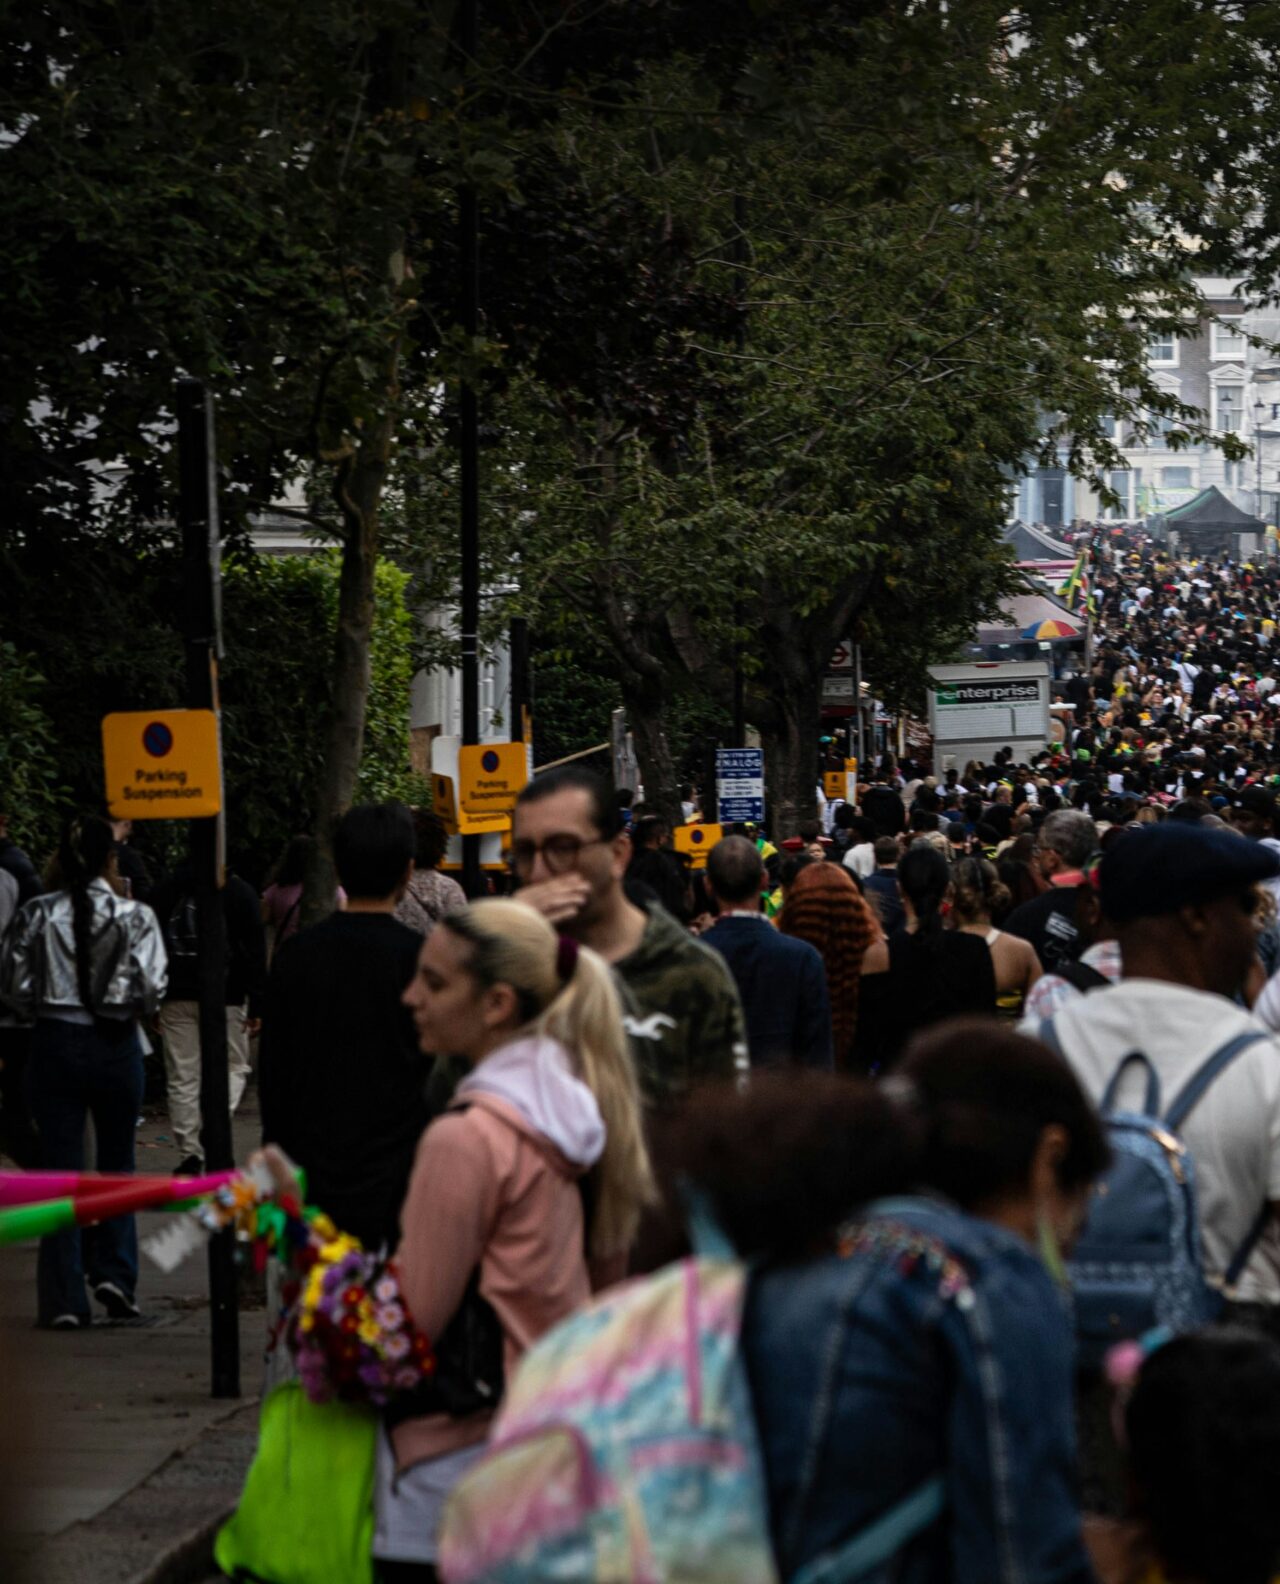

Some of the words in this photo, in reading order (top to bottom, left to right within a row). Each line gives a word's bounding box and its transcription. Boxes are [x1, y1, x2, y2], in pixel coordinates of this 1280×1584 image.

[942, 684, 1038, 700] enterprise
[135, 769, 188, 787] Parking
[476, 780, 508, 790] Parking
[123, 786, 203, 802] Suspension
